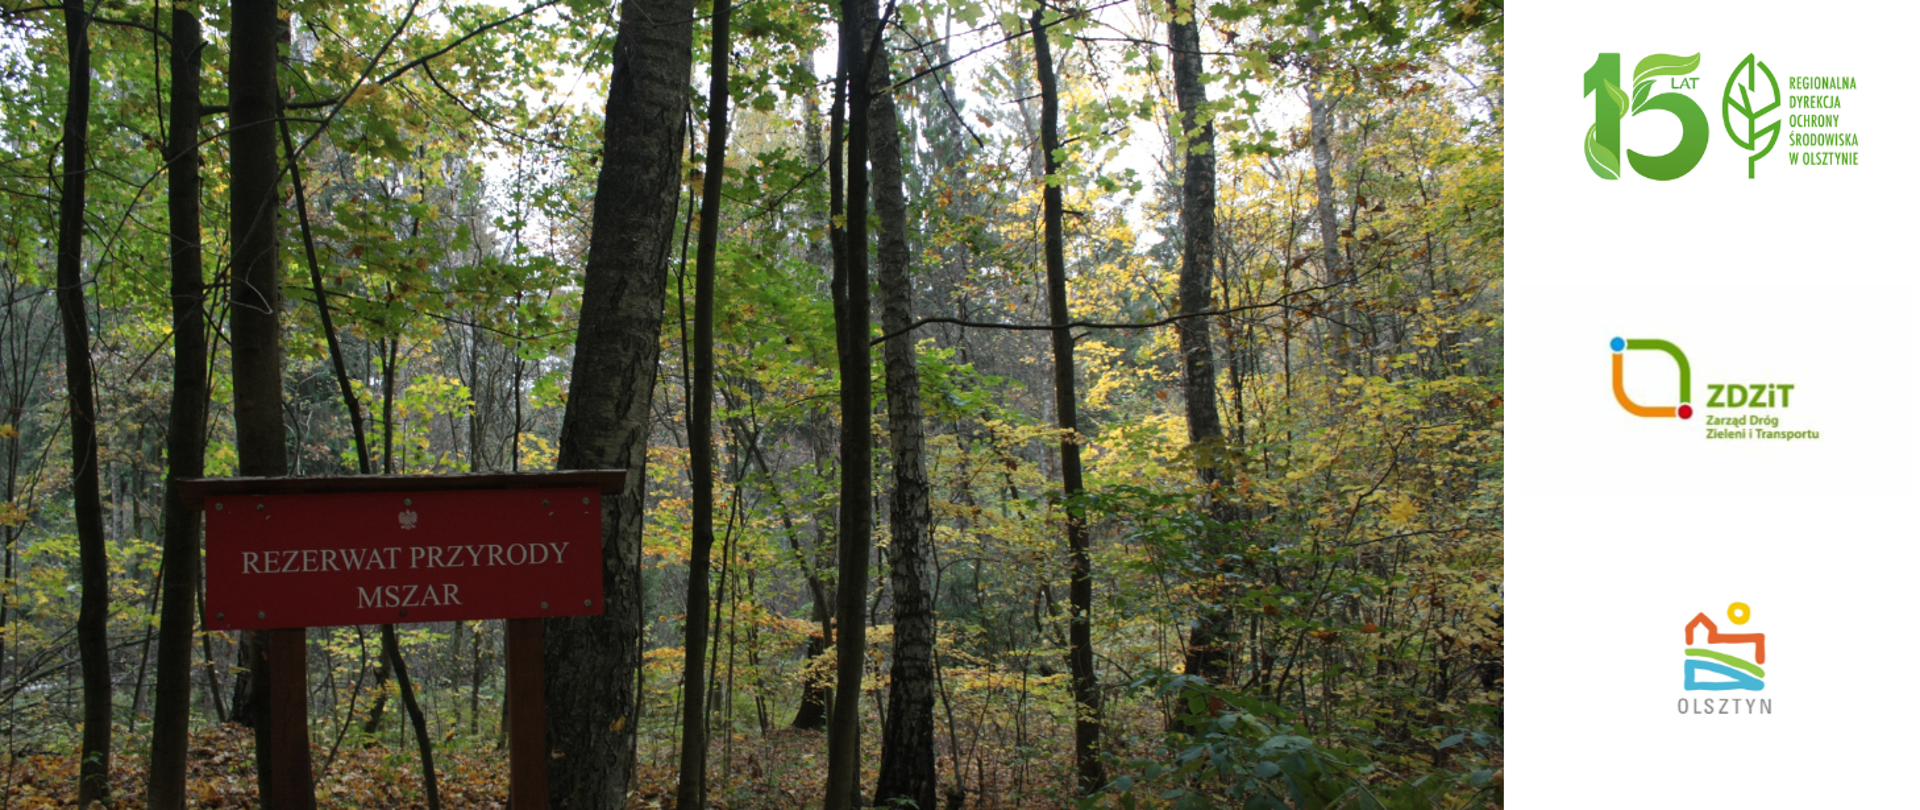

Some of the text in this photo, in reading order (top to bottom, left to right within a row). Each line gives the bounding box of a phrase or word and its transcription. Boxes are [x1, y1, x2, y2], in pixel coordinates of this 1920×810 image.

[242, 542, 570, 574] REZERWAT PRZYRODY
[356, 583, 462, 609] MSZAR
